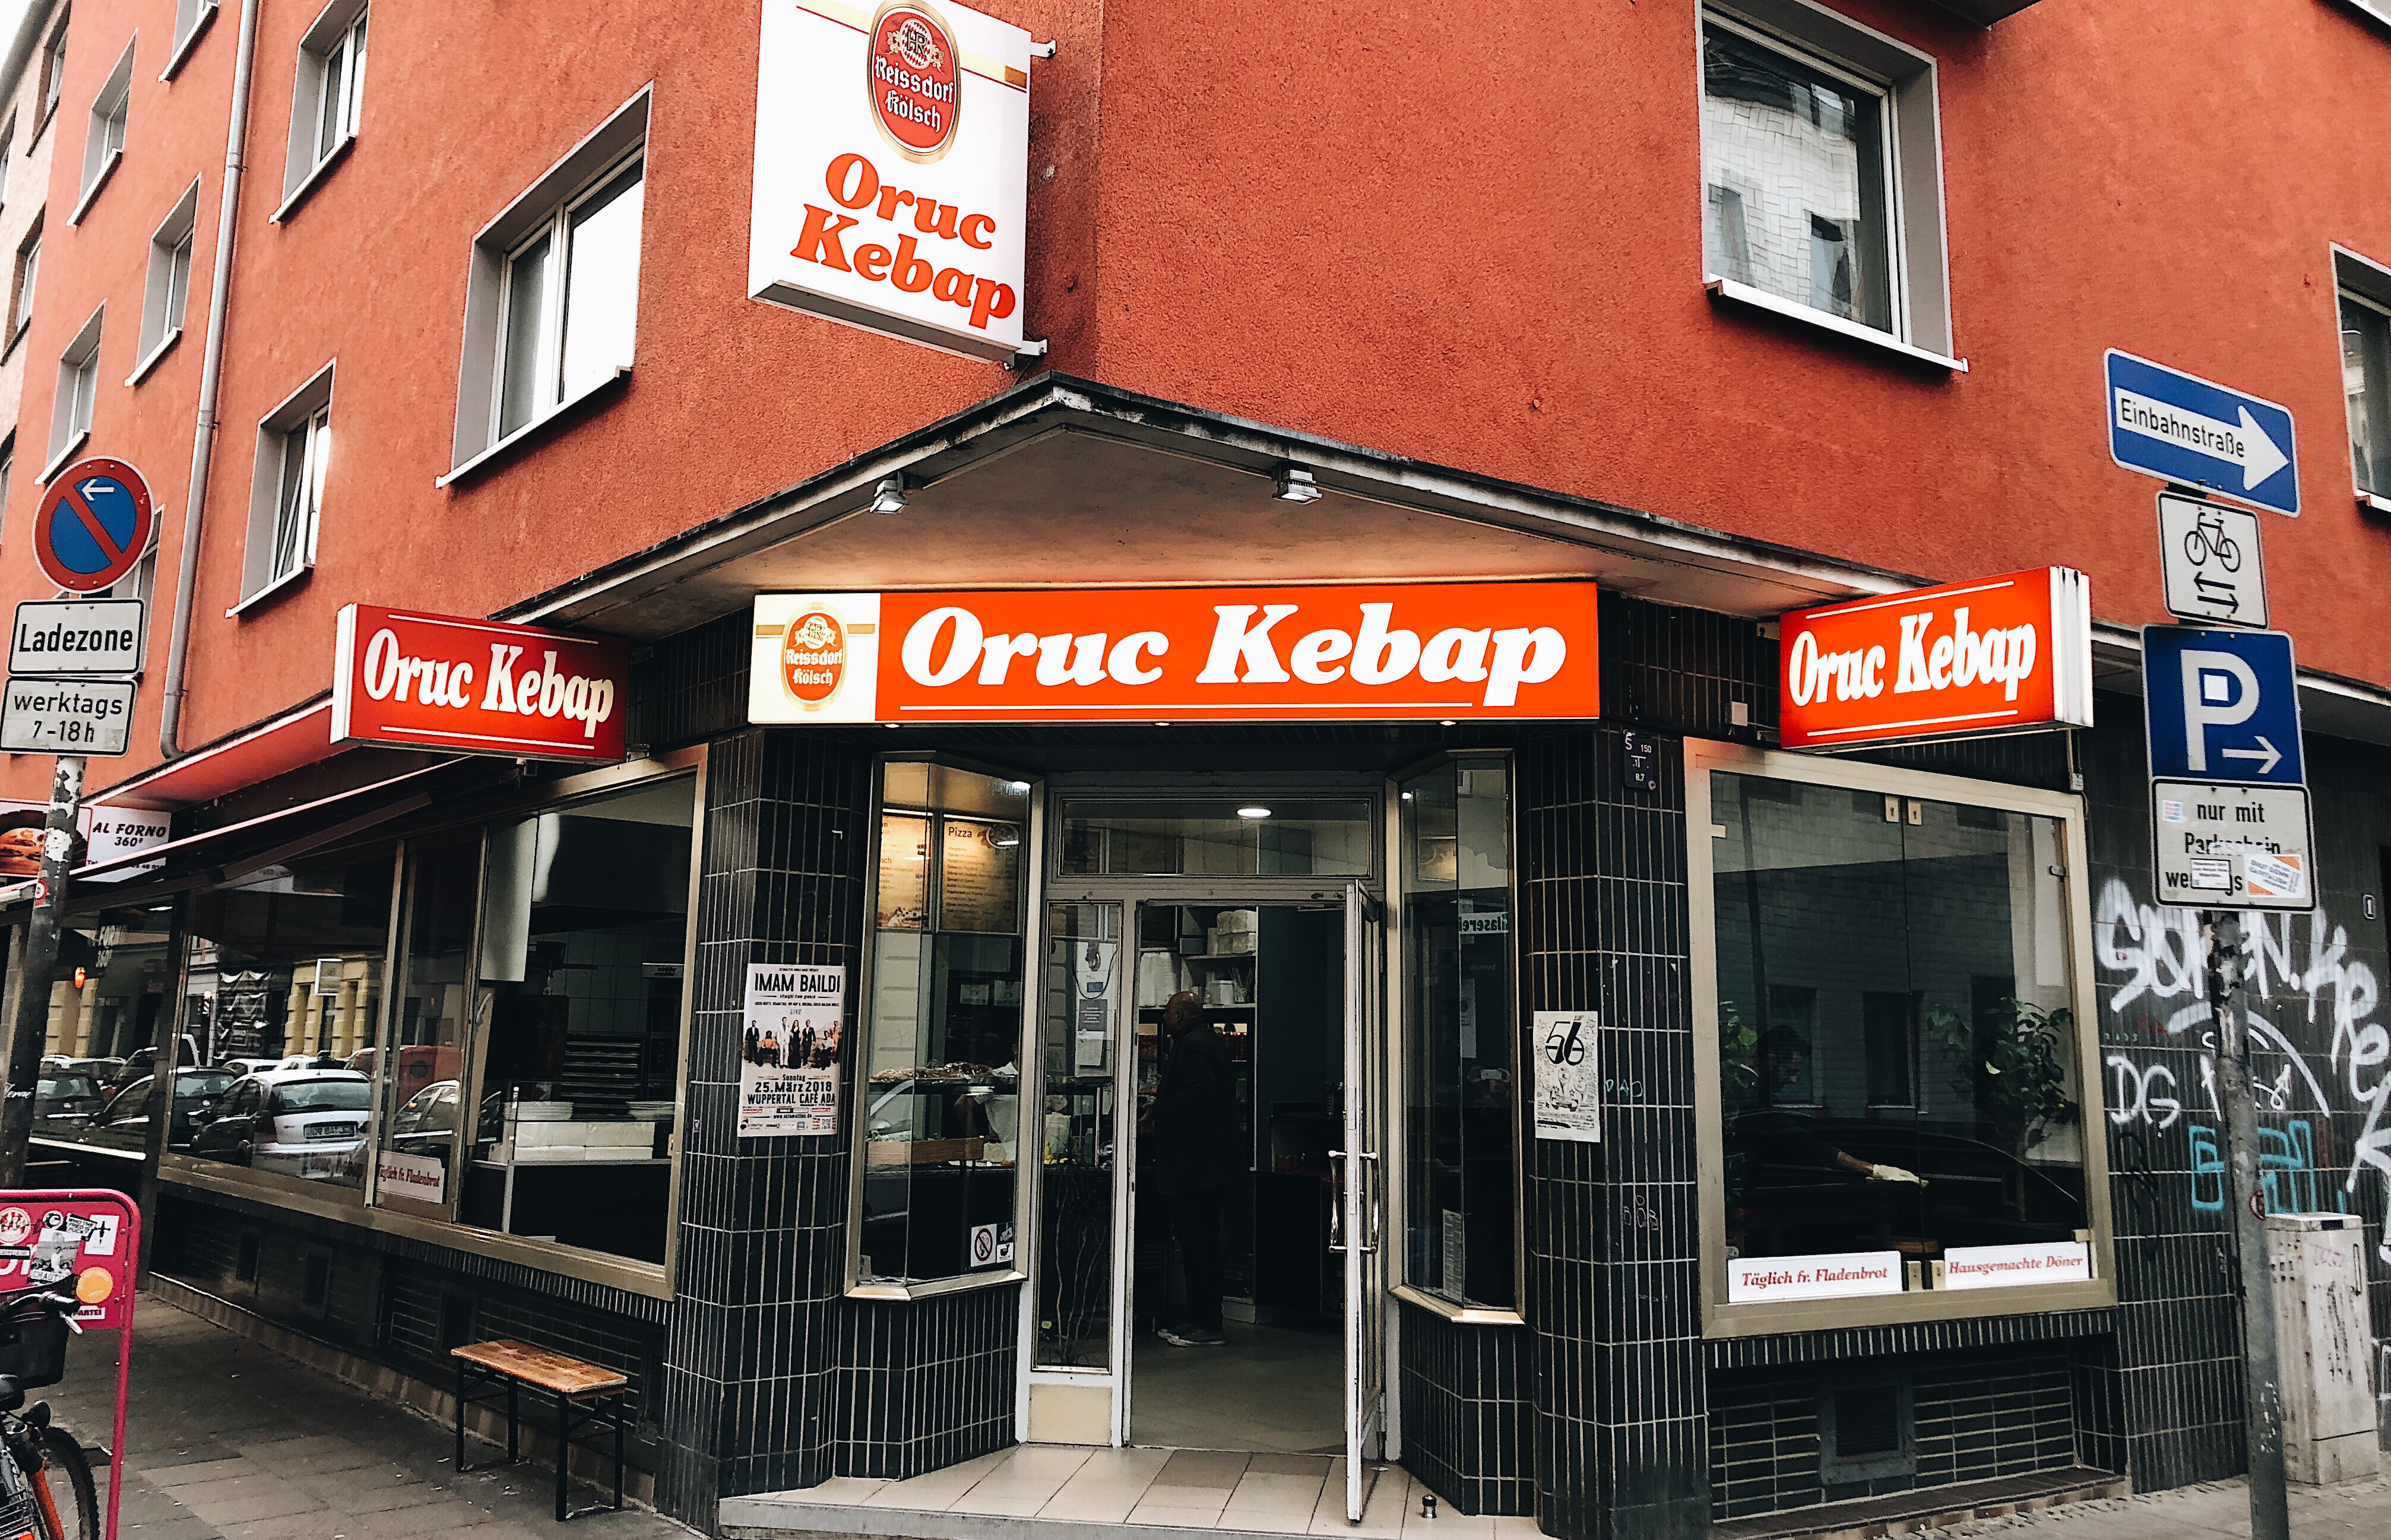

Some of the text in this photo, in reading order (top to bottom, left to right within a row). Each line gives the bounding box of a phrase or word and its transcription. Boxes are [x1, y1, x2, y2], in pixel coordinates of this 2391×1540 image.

[875, 55, 955, 103] Reissdorf
[885, 90, 941, 132] Kölsch
[825, 153, 996, 249] Oruc
[790, 204, 1016, 329] Kebap
[2121, 398, 2244, 458] Einbahnstraße
[19, 623, 133, 652] Ladezone
[786, 648, 843, 666] Reissdorf
[900, 602, 1567, 706] Oruc Kebap
[1789, 606, 2037, 706] Oruc Kebap
[363, 628, 614, 738] Oruc Kebap
[793, 668, 833, 686] Kölsch
[14, 692, 123, 720] werktags
[2180, 649, 2260, 771] P
[2197, 804, 2226, 820] nur
[2235, 801, 2265, 823] mit
[93, 822, 166, 837] AL FORNO
[948, 826, 972, 838] Pizza
[755, 973, 840, 993] IMAM BAILDI
[748, 1094, 796, 1104] WUPPERTAL
[821, 1094, 835, 1104] ADA
[806, 1082, 832, 1092] 2018
[1742, 1267, 1888, 1289] Täglich fr. Fladenbrot
[1949, 1256, 2083, 1275] Hausgemachte Döner
